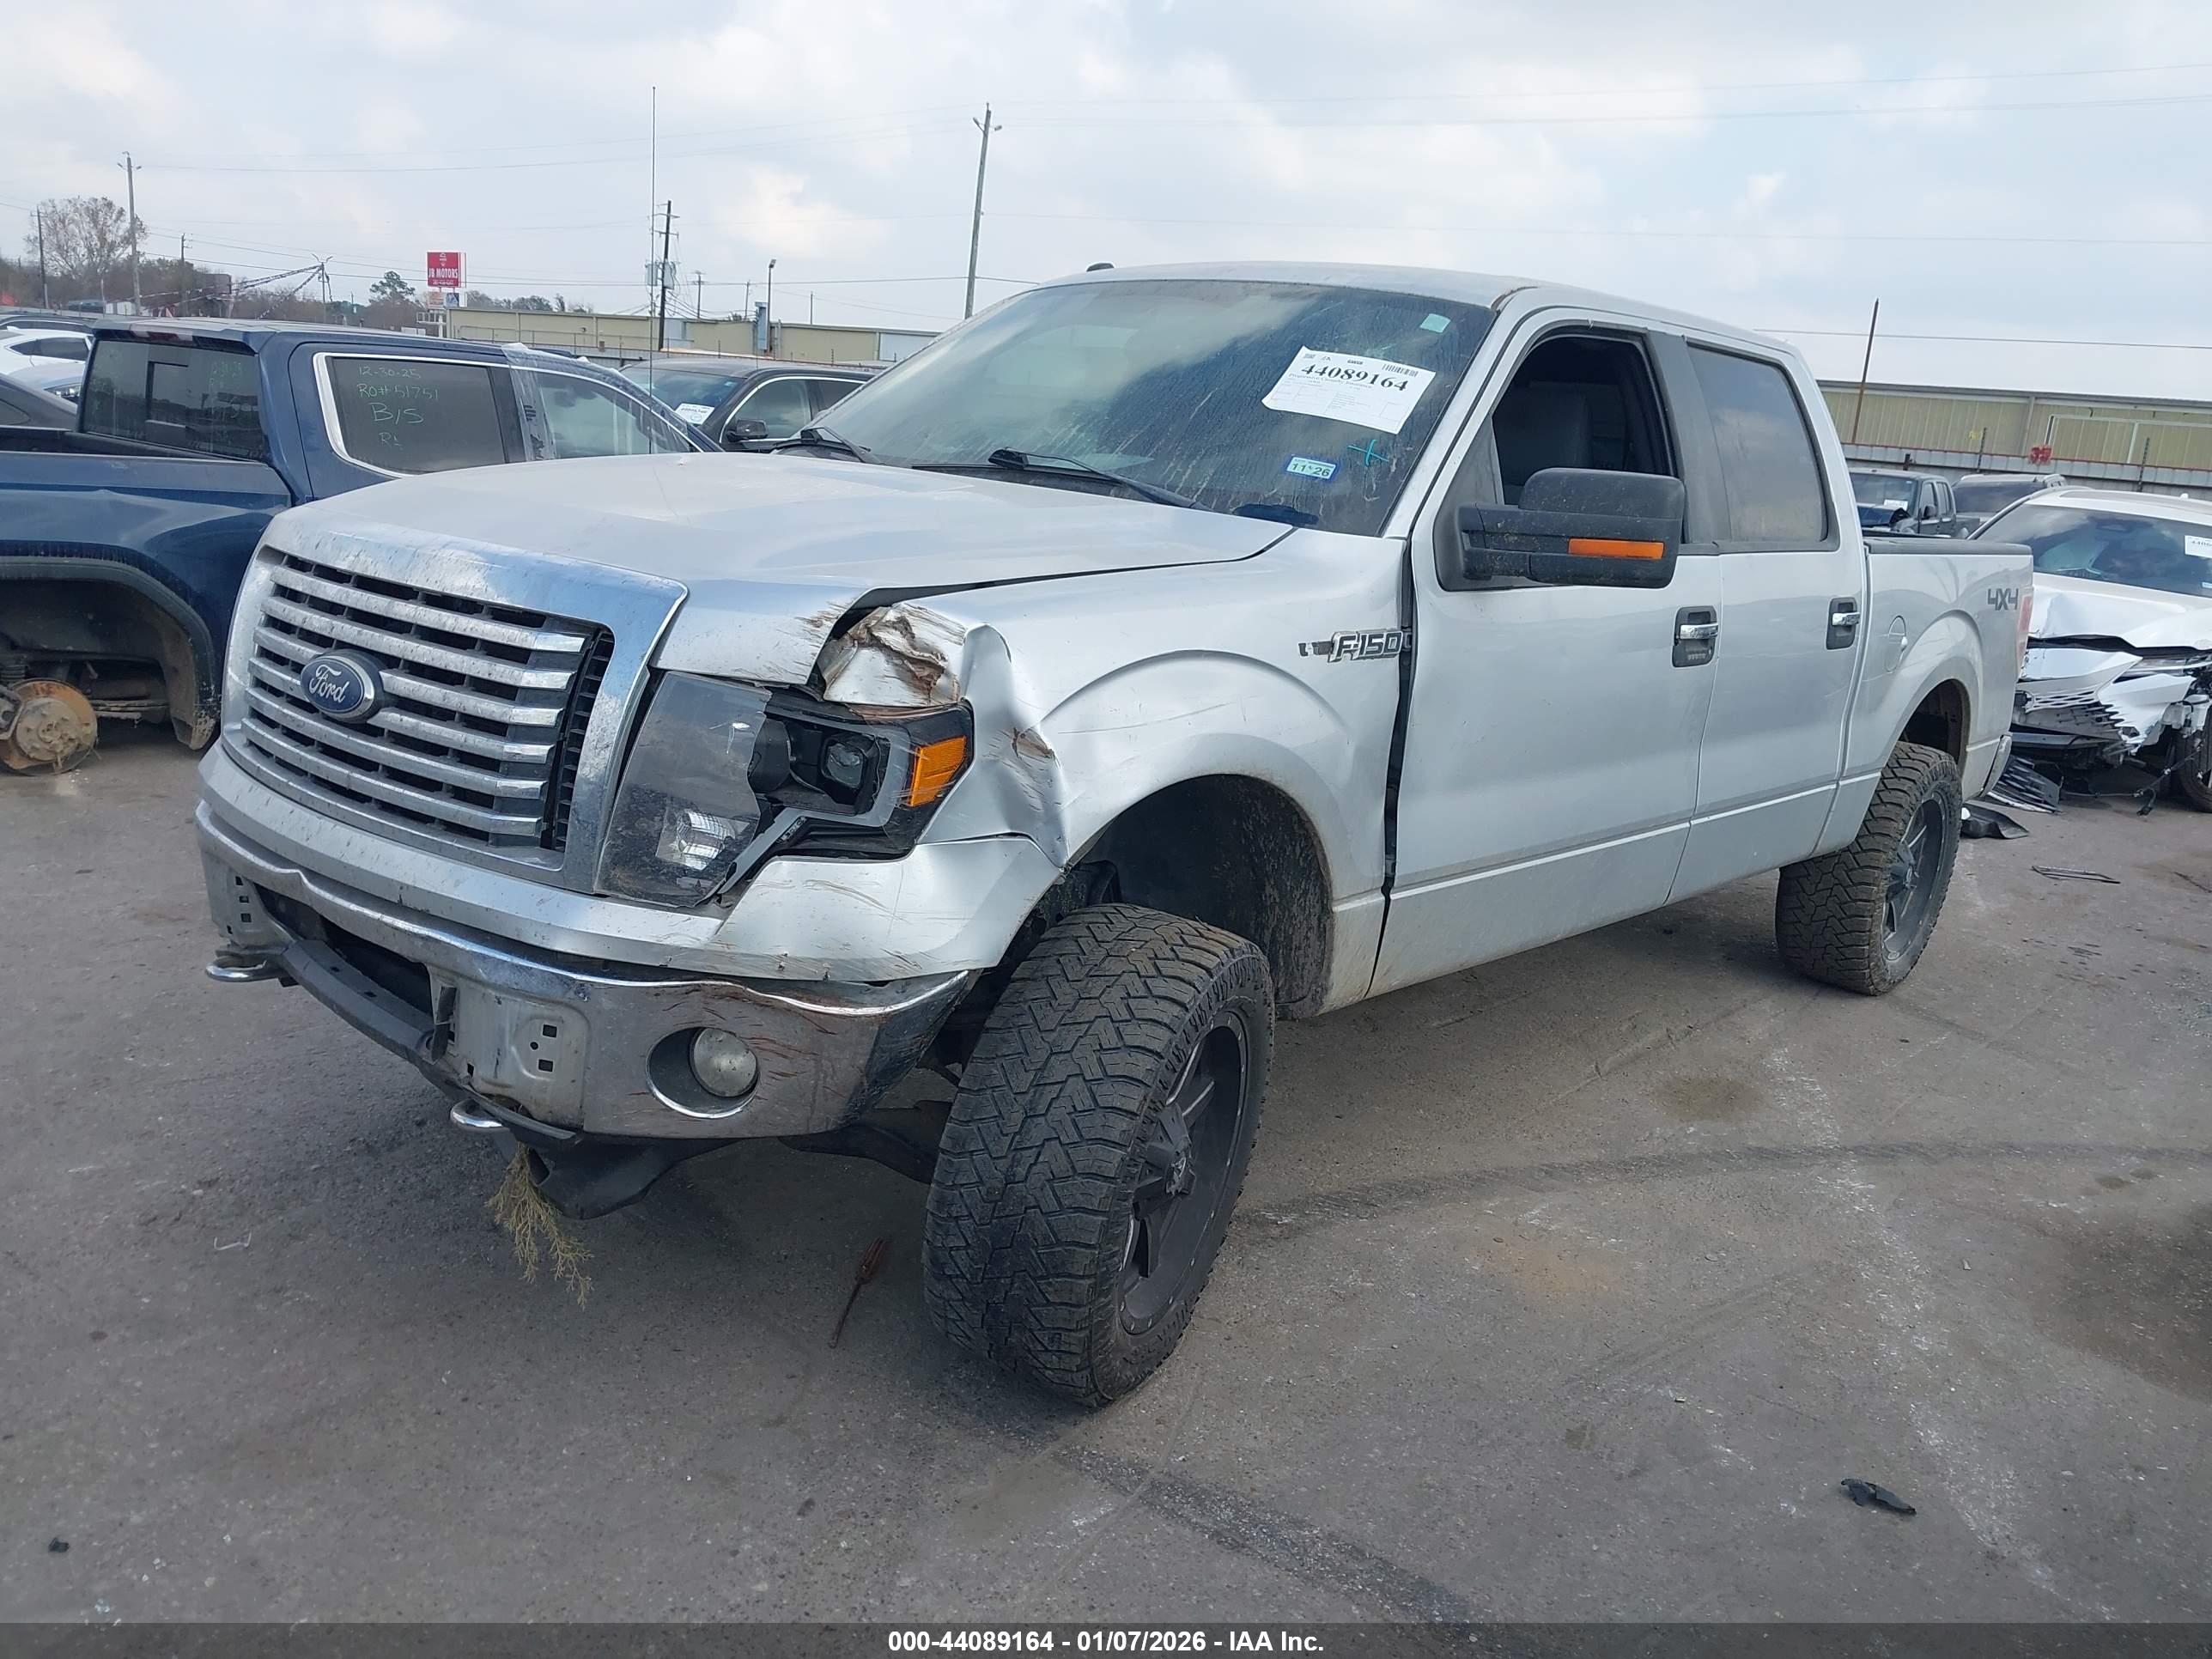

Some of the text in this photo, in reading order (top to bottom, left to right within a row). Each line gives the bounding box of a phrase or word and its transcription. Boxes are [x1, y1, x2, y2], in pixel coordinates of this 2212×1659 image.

[436, 268, 459, 279] MOTORS
[1301, 363, 1409, 391] 44089164
[368, 402, 424, 425] B/S
[1312, 466, 1332, 477] 26
[309, 665, 350, 702] Ford
